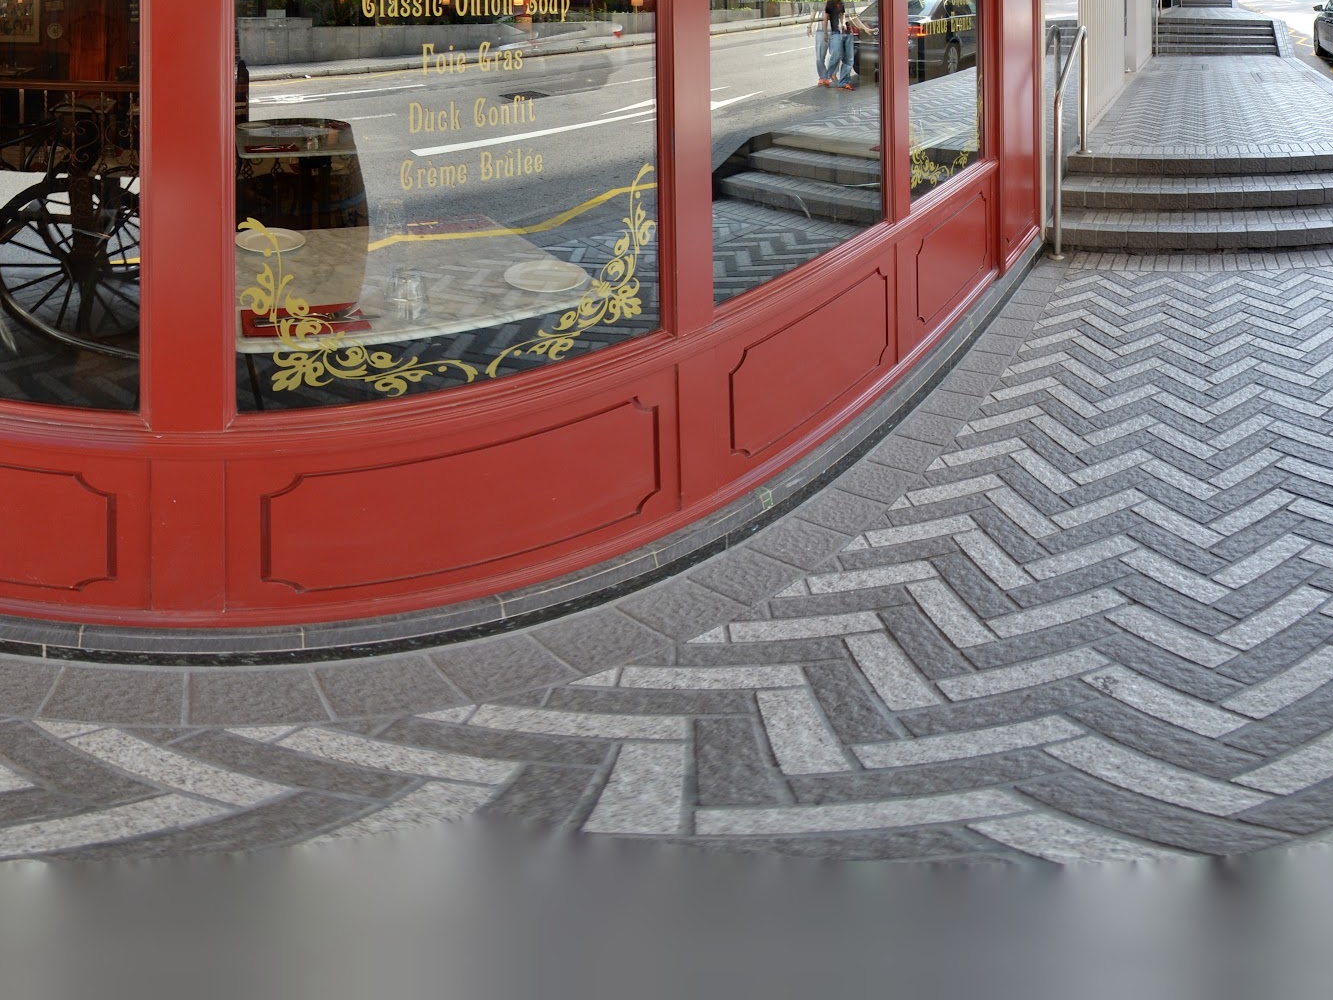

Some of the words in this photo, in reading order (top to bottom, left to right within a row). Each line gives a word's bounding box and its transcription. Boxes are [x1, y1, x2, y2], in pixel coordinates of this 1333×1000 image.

[422, 43, 467, 75] Foie
[478, 41, 524, 72] Gras
[409, 100, 462, 134] Duck
[473, 95, 536, 128] Confit
[400, 159, 468, 190] Crème
[480, 147, 544, 181] Brûlée
